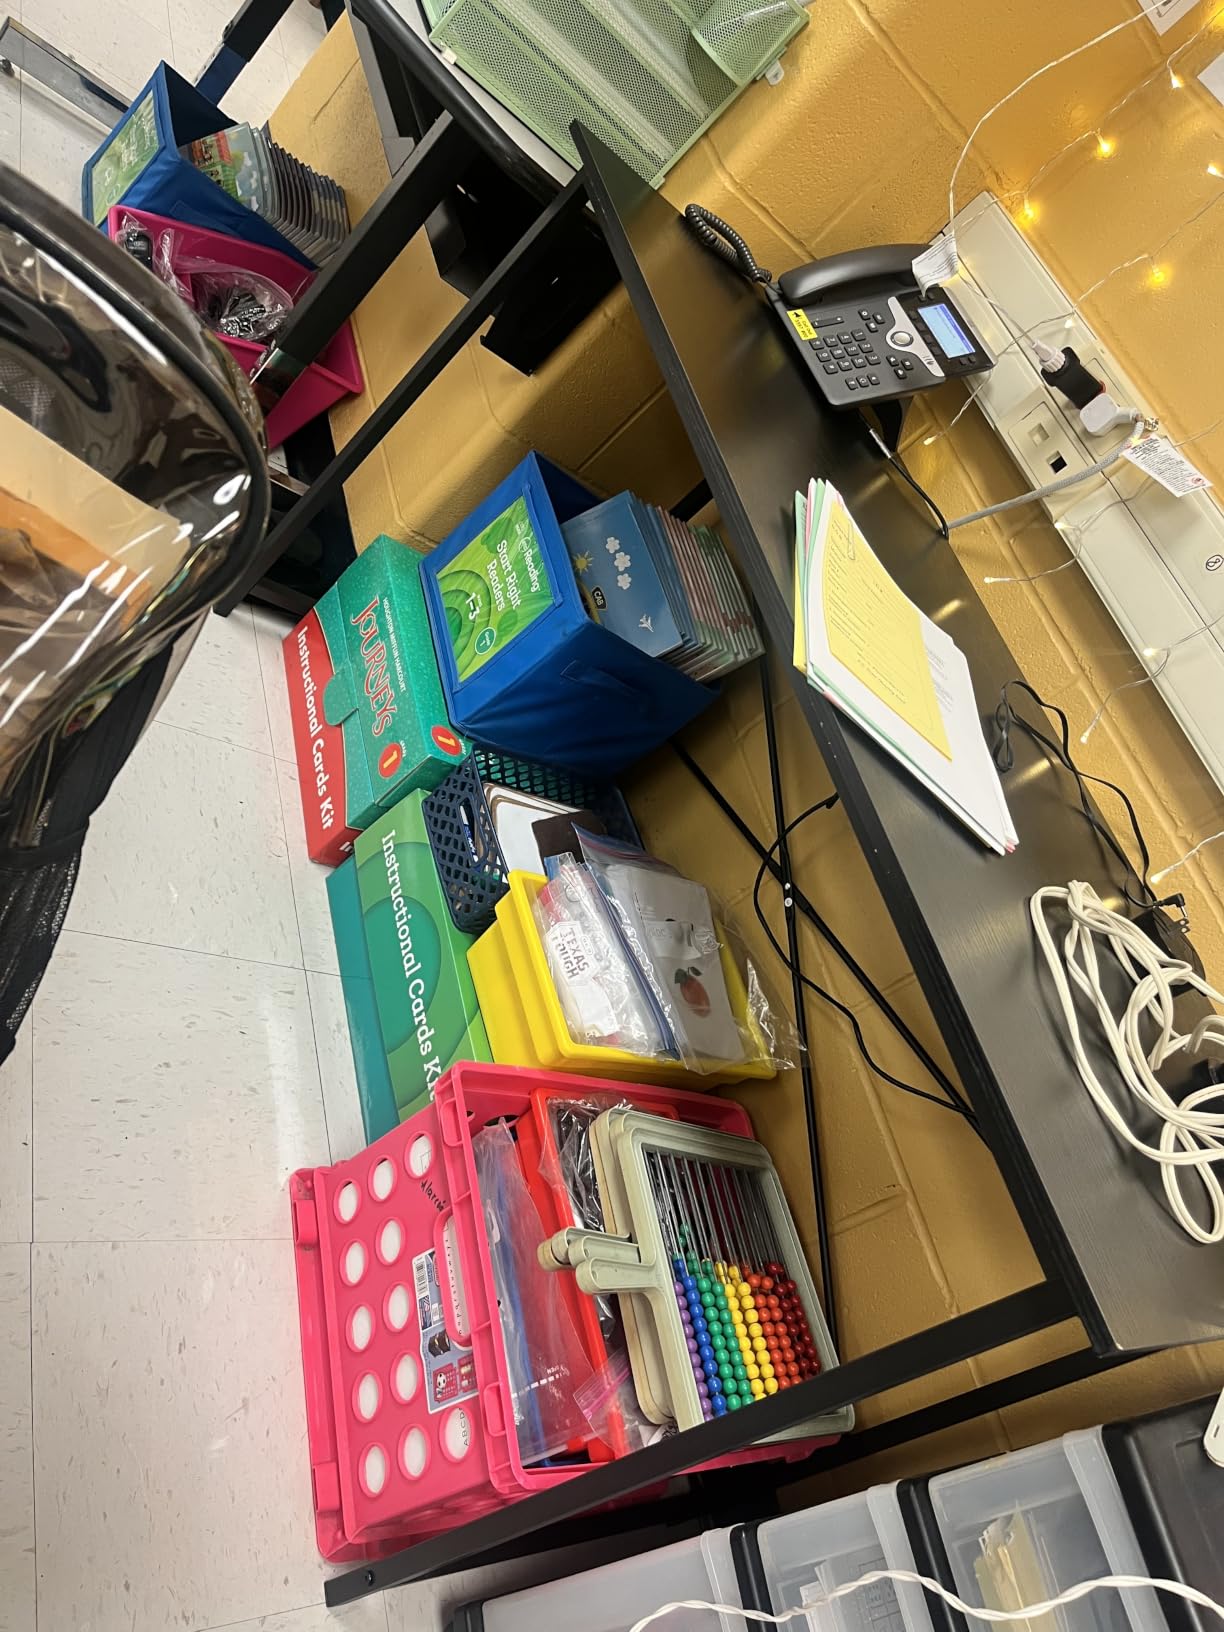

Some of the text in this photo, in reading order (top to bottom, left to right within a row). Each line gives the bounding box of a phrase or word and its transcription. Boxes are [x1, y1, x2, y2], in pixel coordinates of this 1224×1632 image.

[487, 558, 507, 612] Readers
[497, 539, 522, 610] Start Right
[522, 548, 541, 594] Reading
[593, 590, 605, 606] CAB
[351, 593, 398, 737] JOURNEYS
[382, 597, 394, 633] HOUGHTON
[394, 656, 406, 692] HARCOURT
[297, 626, 334, 831] Instructional Cards Kit
[437, 735, 457, 747] 1
[383, 750, 398, 769] 1
[381, 829, 422, 979] Instructional
[408, 978, 435, 1056] Cards
[562, 927, 590, 972] TEXAS
